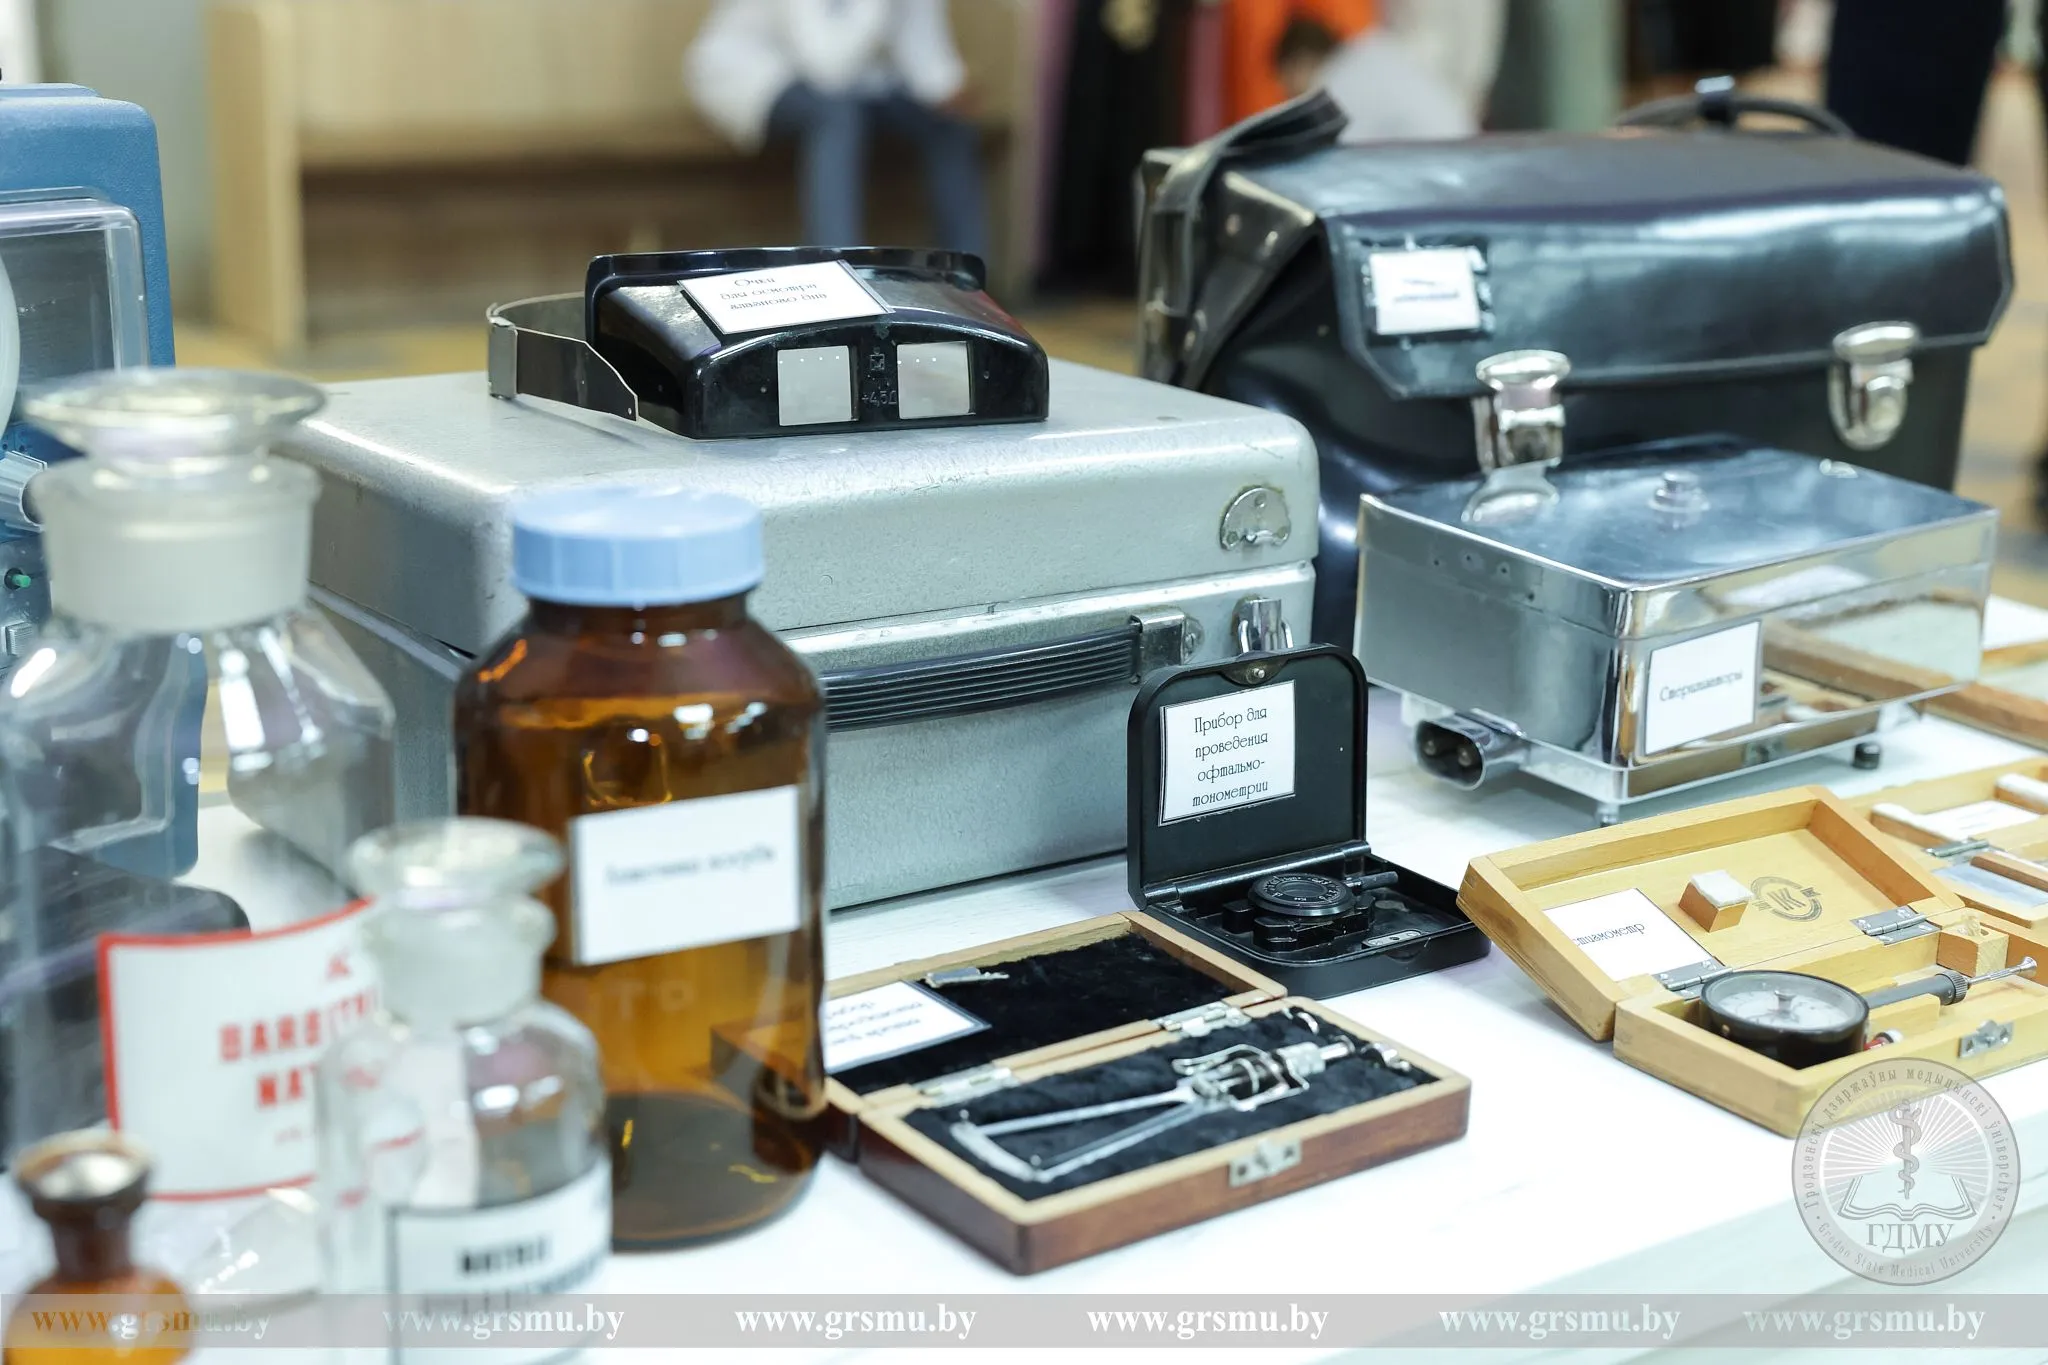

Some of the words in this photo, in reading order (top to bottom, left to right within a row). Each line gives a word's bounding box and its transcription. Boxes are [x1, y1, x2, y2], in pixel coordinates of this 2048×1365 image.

[1194, 711, 1243, 736] Прибор
[1246, 707, 1268, 722] для
[1195, 732, 1269, 761] проведения
[1197, 759, 1266, 784] офтальмо-
[1192, 780, 1269, 807] тонометрии
